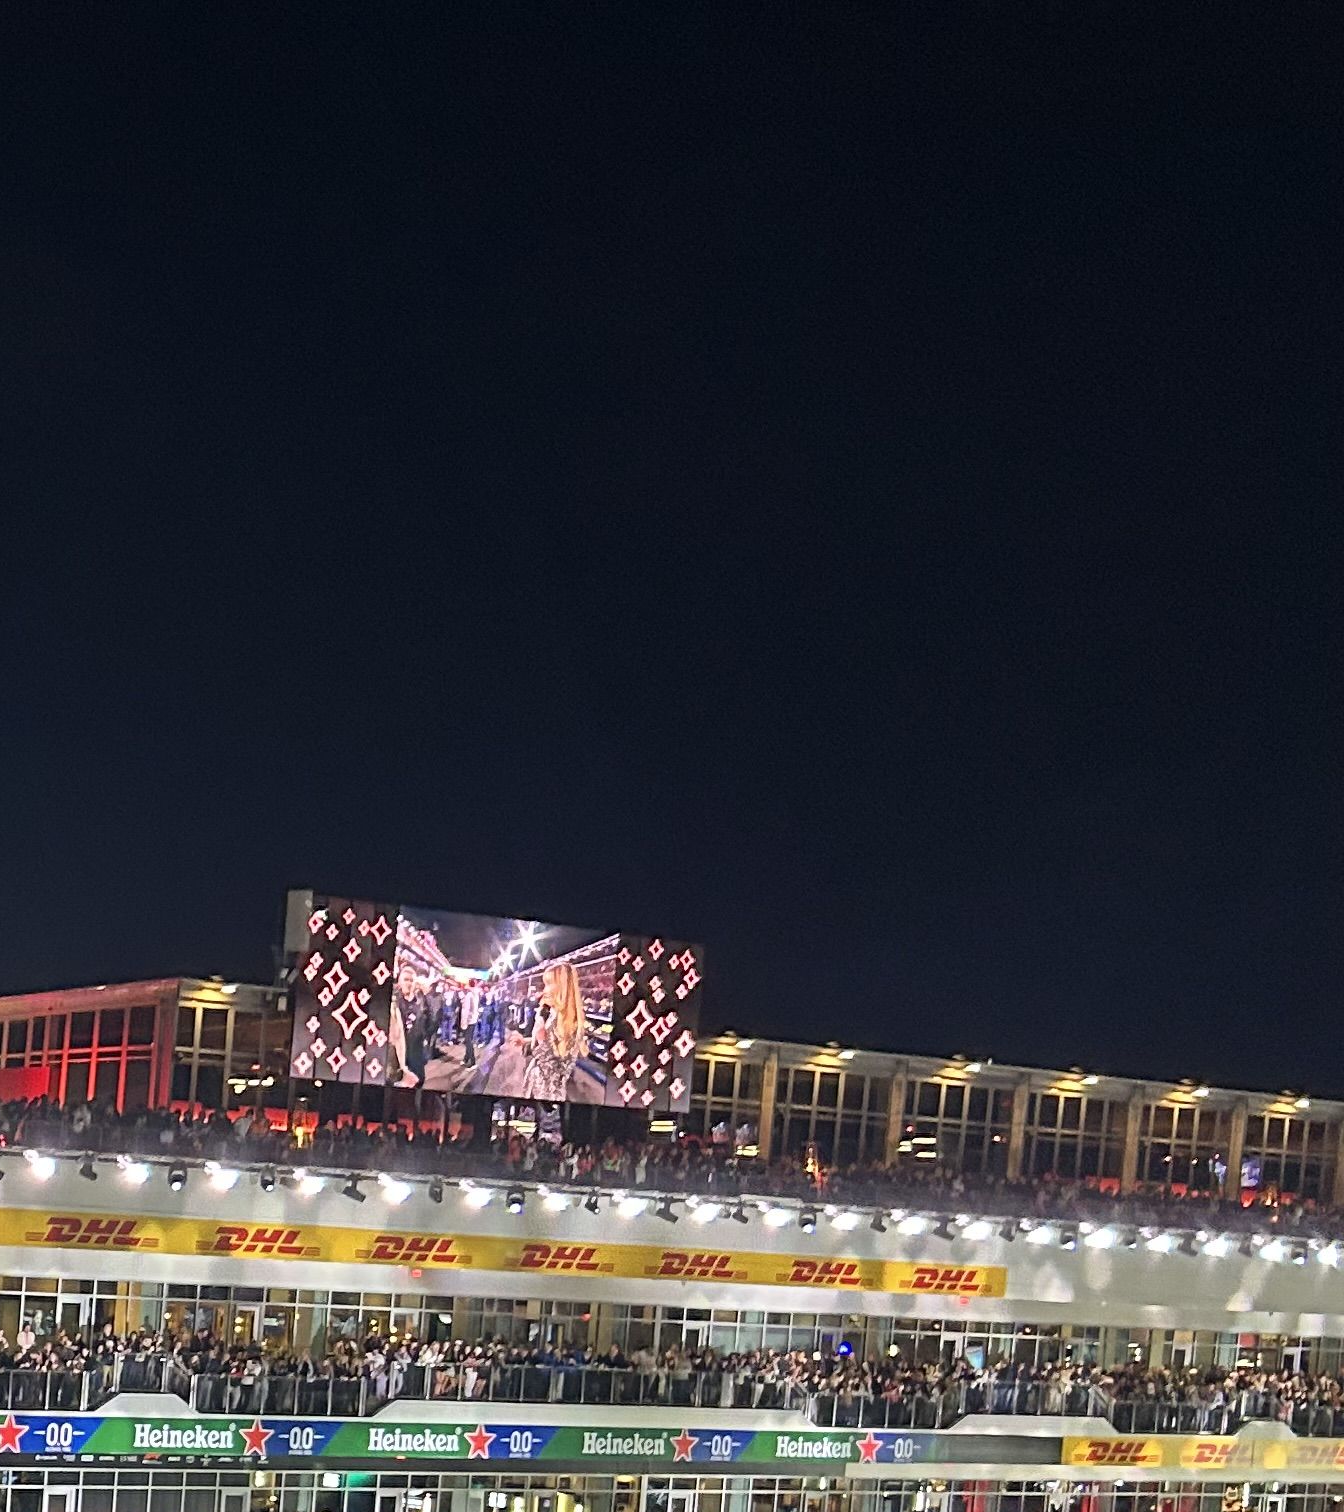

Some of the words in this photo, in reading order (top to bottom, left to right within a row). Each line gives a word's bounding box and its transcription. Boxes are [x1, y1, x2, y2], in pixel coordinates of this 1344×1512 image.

[43, 1217, 139, 1246] DHL
[213, 1226, 305, 1255] DHL
[372, 1235, 458, 1263] DHL
[520, 1243, 598, 1271] DHL
[657, 1252, 734, 1278] DHL
[790, 1260, 861, 1285] DHL
[911, 1267, 978, 1292] DHL
[133, 1424, 234, 1450] Heineken
[368, 1428, 461, 1452] Heineken
[582, 1432, 667, 1456] Heineken
[775, 1436, 853, 1459] Heineken
[1086, 1442, 1147, 1462] DHL
[1194, 1444, 1251, 1463] DHL
